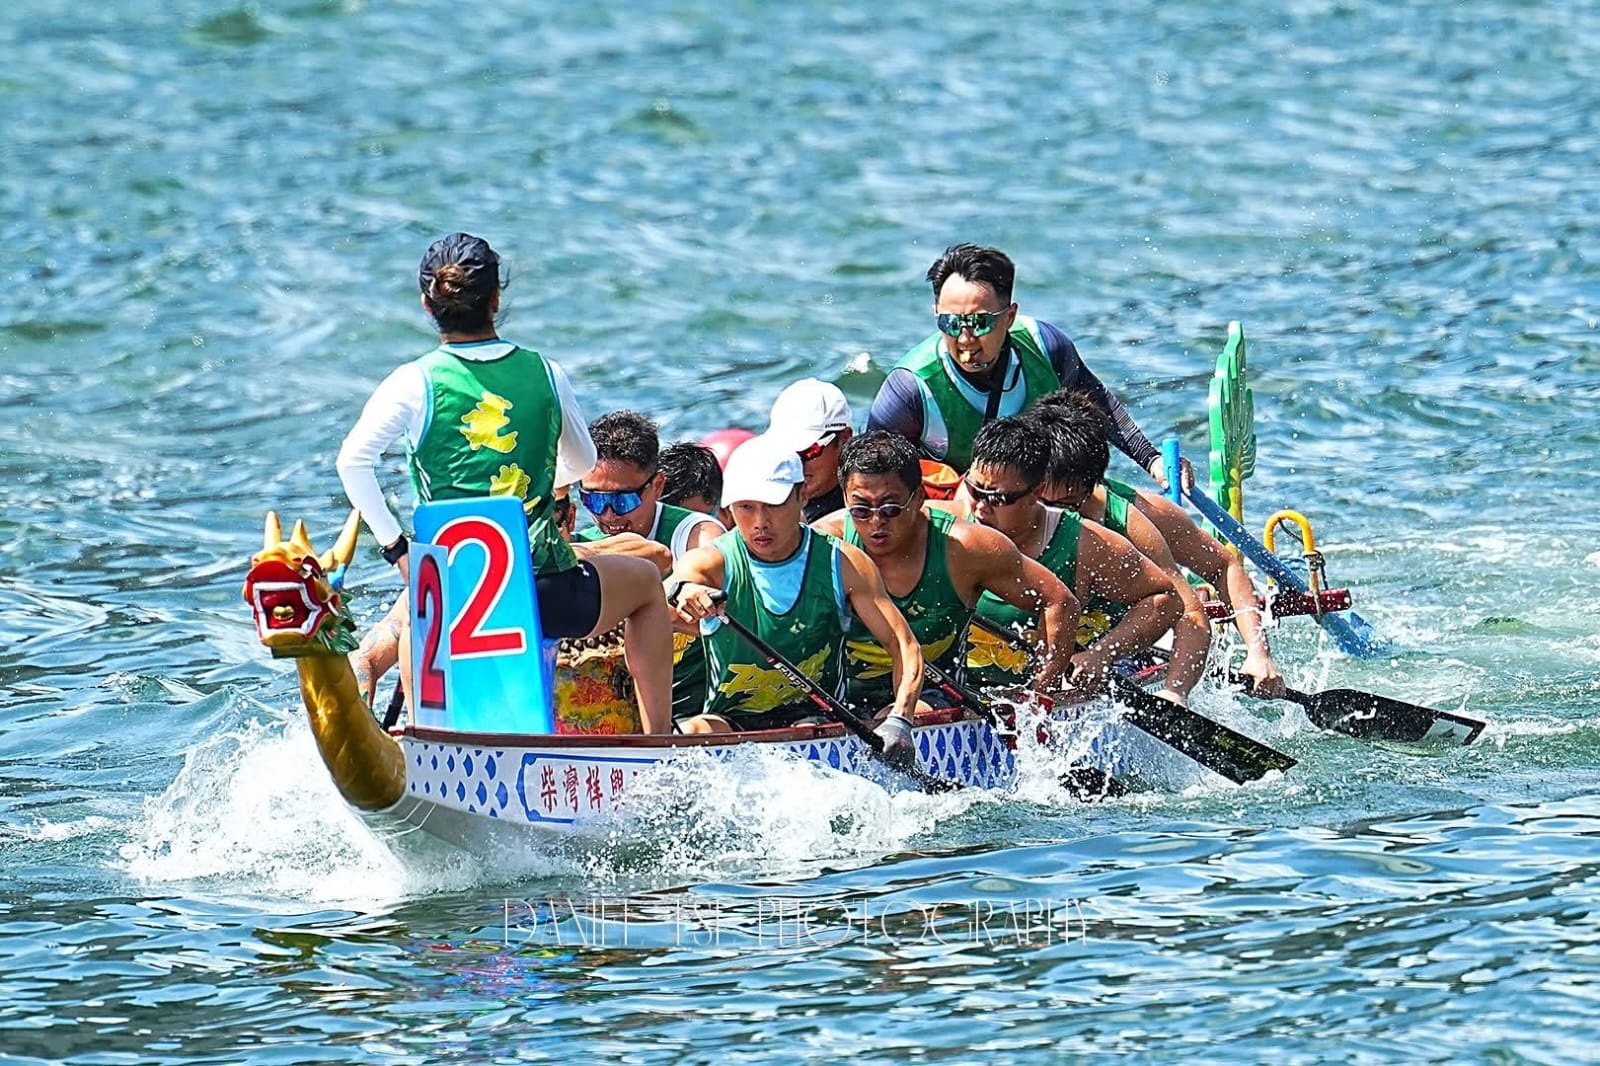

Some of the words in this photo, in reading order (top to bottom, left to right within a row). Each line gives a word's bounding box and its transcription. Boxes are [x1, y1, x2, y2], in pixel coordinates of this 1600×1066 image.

[417, 553, 446, 710] 2
[431, 515, 527, 660] 2
[540, 764, 637, 814] 柴灣祥興
